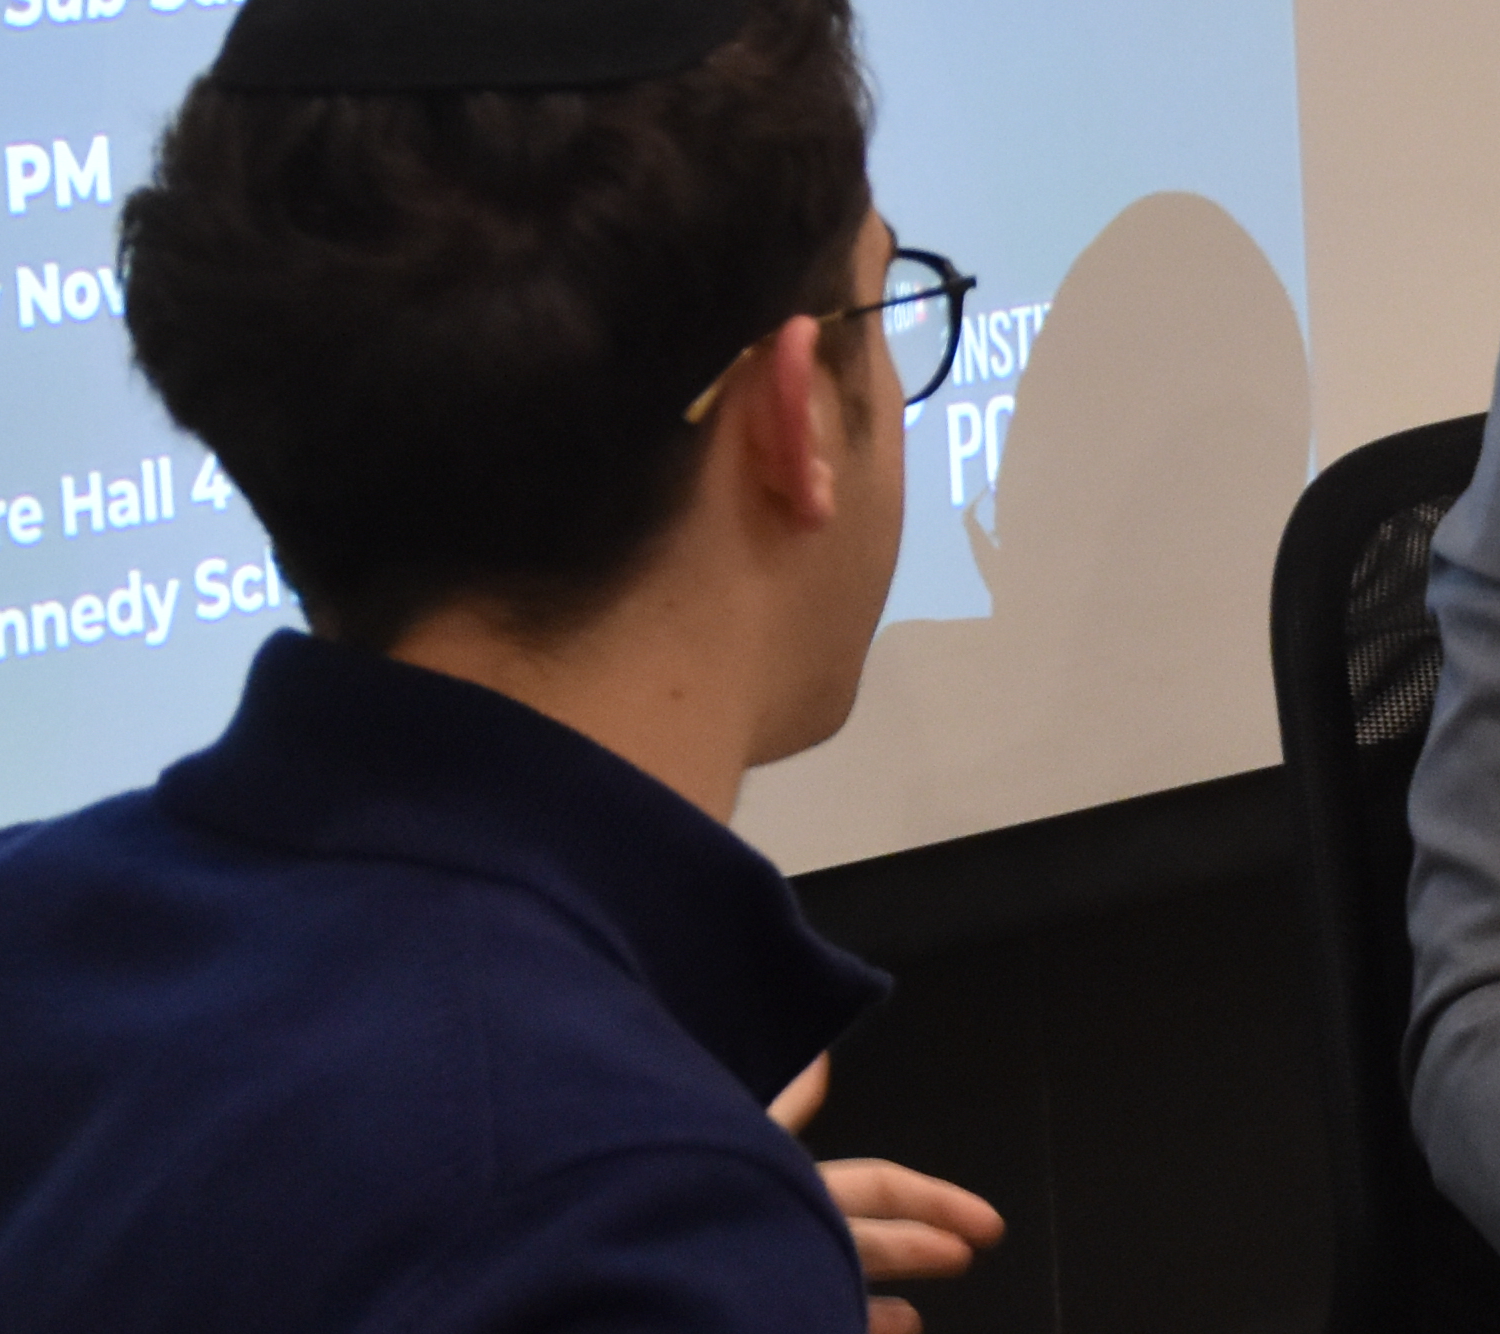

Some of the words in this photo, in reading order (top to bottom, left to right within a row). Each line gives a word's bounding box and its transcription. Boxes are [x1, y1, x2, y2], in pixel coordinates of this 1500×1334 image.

[4, 133, 112, 212] PM
[60, 454, 175, 534] Hall
[191, 453, 235, 511] 4
